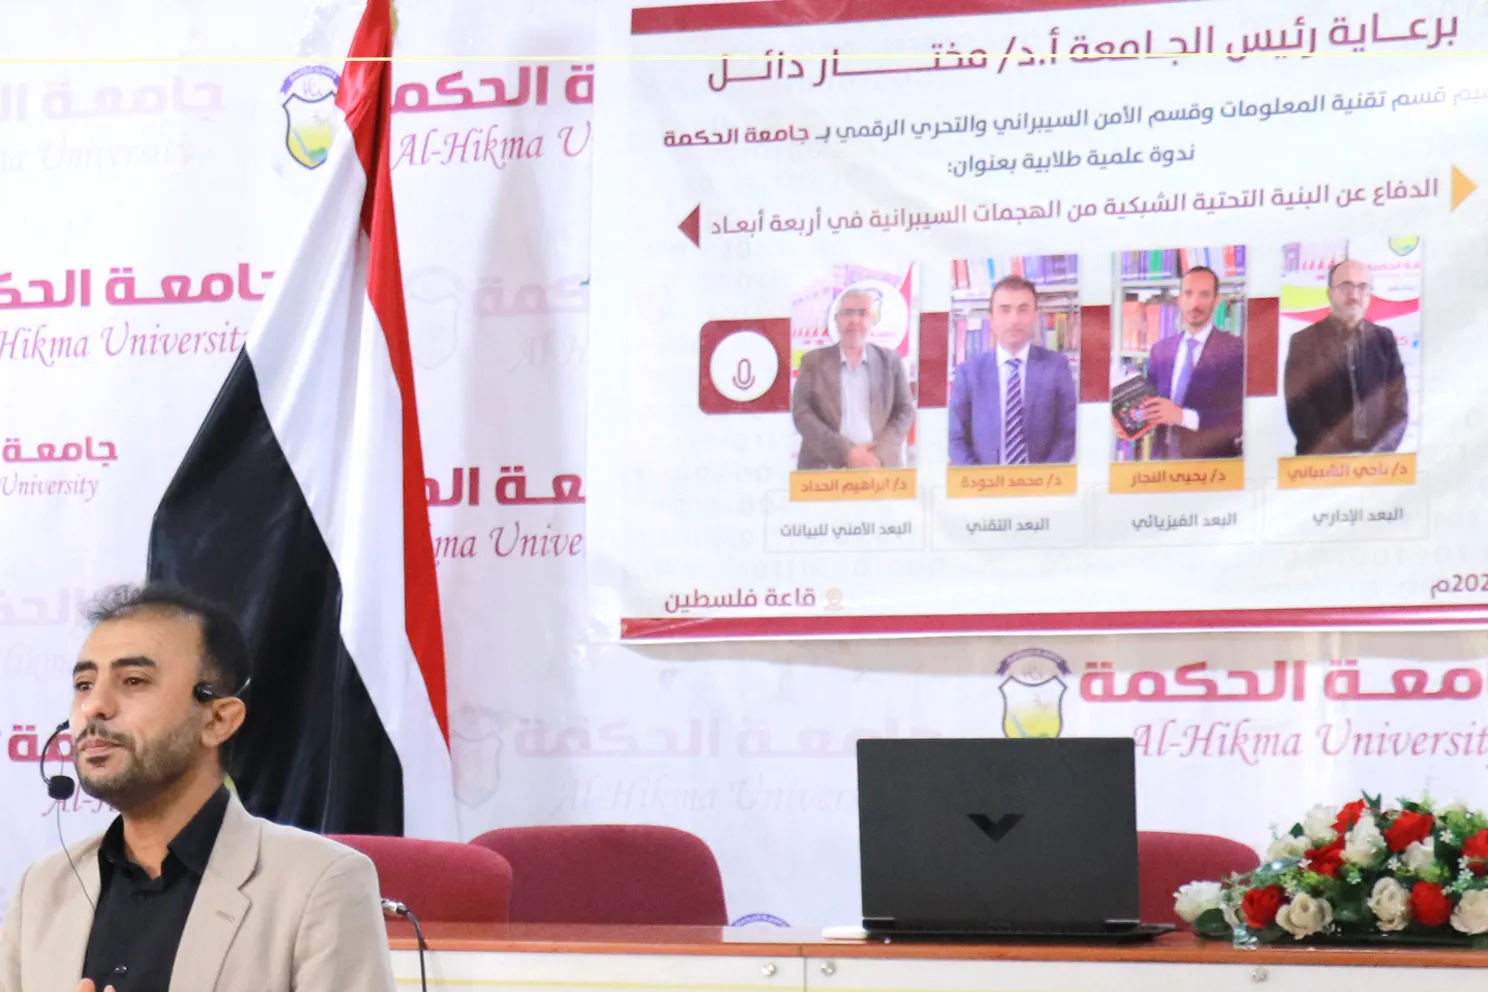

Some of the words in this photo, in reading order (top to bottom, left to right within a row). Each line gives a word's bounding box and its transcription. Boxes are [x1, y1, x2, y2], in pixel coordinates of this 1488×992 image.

[1069, 26, 1215, 65] الجامعة
[1226, 16, 1317, 62] رئيس
[1328, 13, 1458, 53] برعاية
[813, 42, 987, 86] مختار
[391, 65, 549, 115] الحكم
[1331, 91, 1387, 115] تقنية
[1391, 87, 1446, 111] قسم
[1094, 106, 1142, 130] الأمن
[1148, 103, 1214, 127] وقسم
[1220, 94, 1325, 121] المعلومات
[745, 125, 809, 145] جامعة
[836, 119, 905, 142] الرقمي
[911, 115, 987, 139] والتحري
[993, 110, 1089, 136] السيبراني
[663, 129, 739, 148] الحكمة
[1022, 151, 1081, 173] طلابية
[1087, 147, 1143, 170] علمية
[1149, 144, 1195, 167] ندوة
[1192, 188, 1264, 214] التحتية
[1271, 184, 1329, 210] البنية
[1336, 186, 1365, 208] عن
[1372, 177, 1438, 206] الدفاع
[869, 205, 966, 232] السيبرانية
[973, 200, 1061, 225] الهجمات
[1067, 203, 1097, 222] من
[1104, 192, 1186, 219] الشبكية
[769, 207, 821, 236] أربعة
[828, 211, 863, 234] في
[100, 319, 250, 357] Universit
[3, 436, 118, 467] جامعة
[0, 473, 99, 503] University
[489, 521, 583, 558] Unive
[664, 587, 758, 614] فلسطين
[764, 587, 816, 607] قاعة
[1079, 660, 1306, 702] الحكمة
[1323, 659, 1488, 702] معة
[1132, 717, 1302, 766] Al-Hikma
[1316, 717, 1488, 757] Universit
